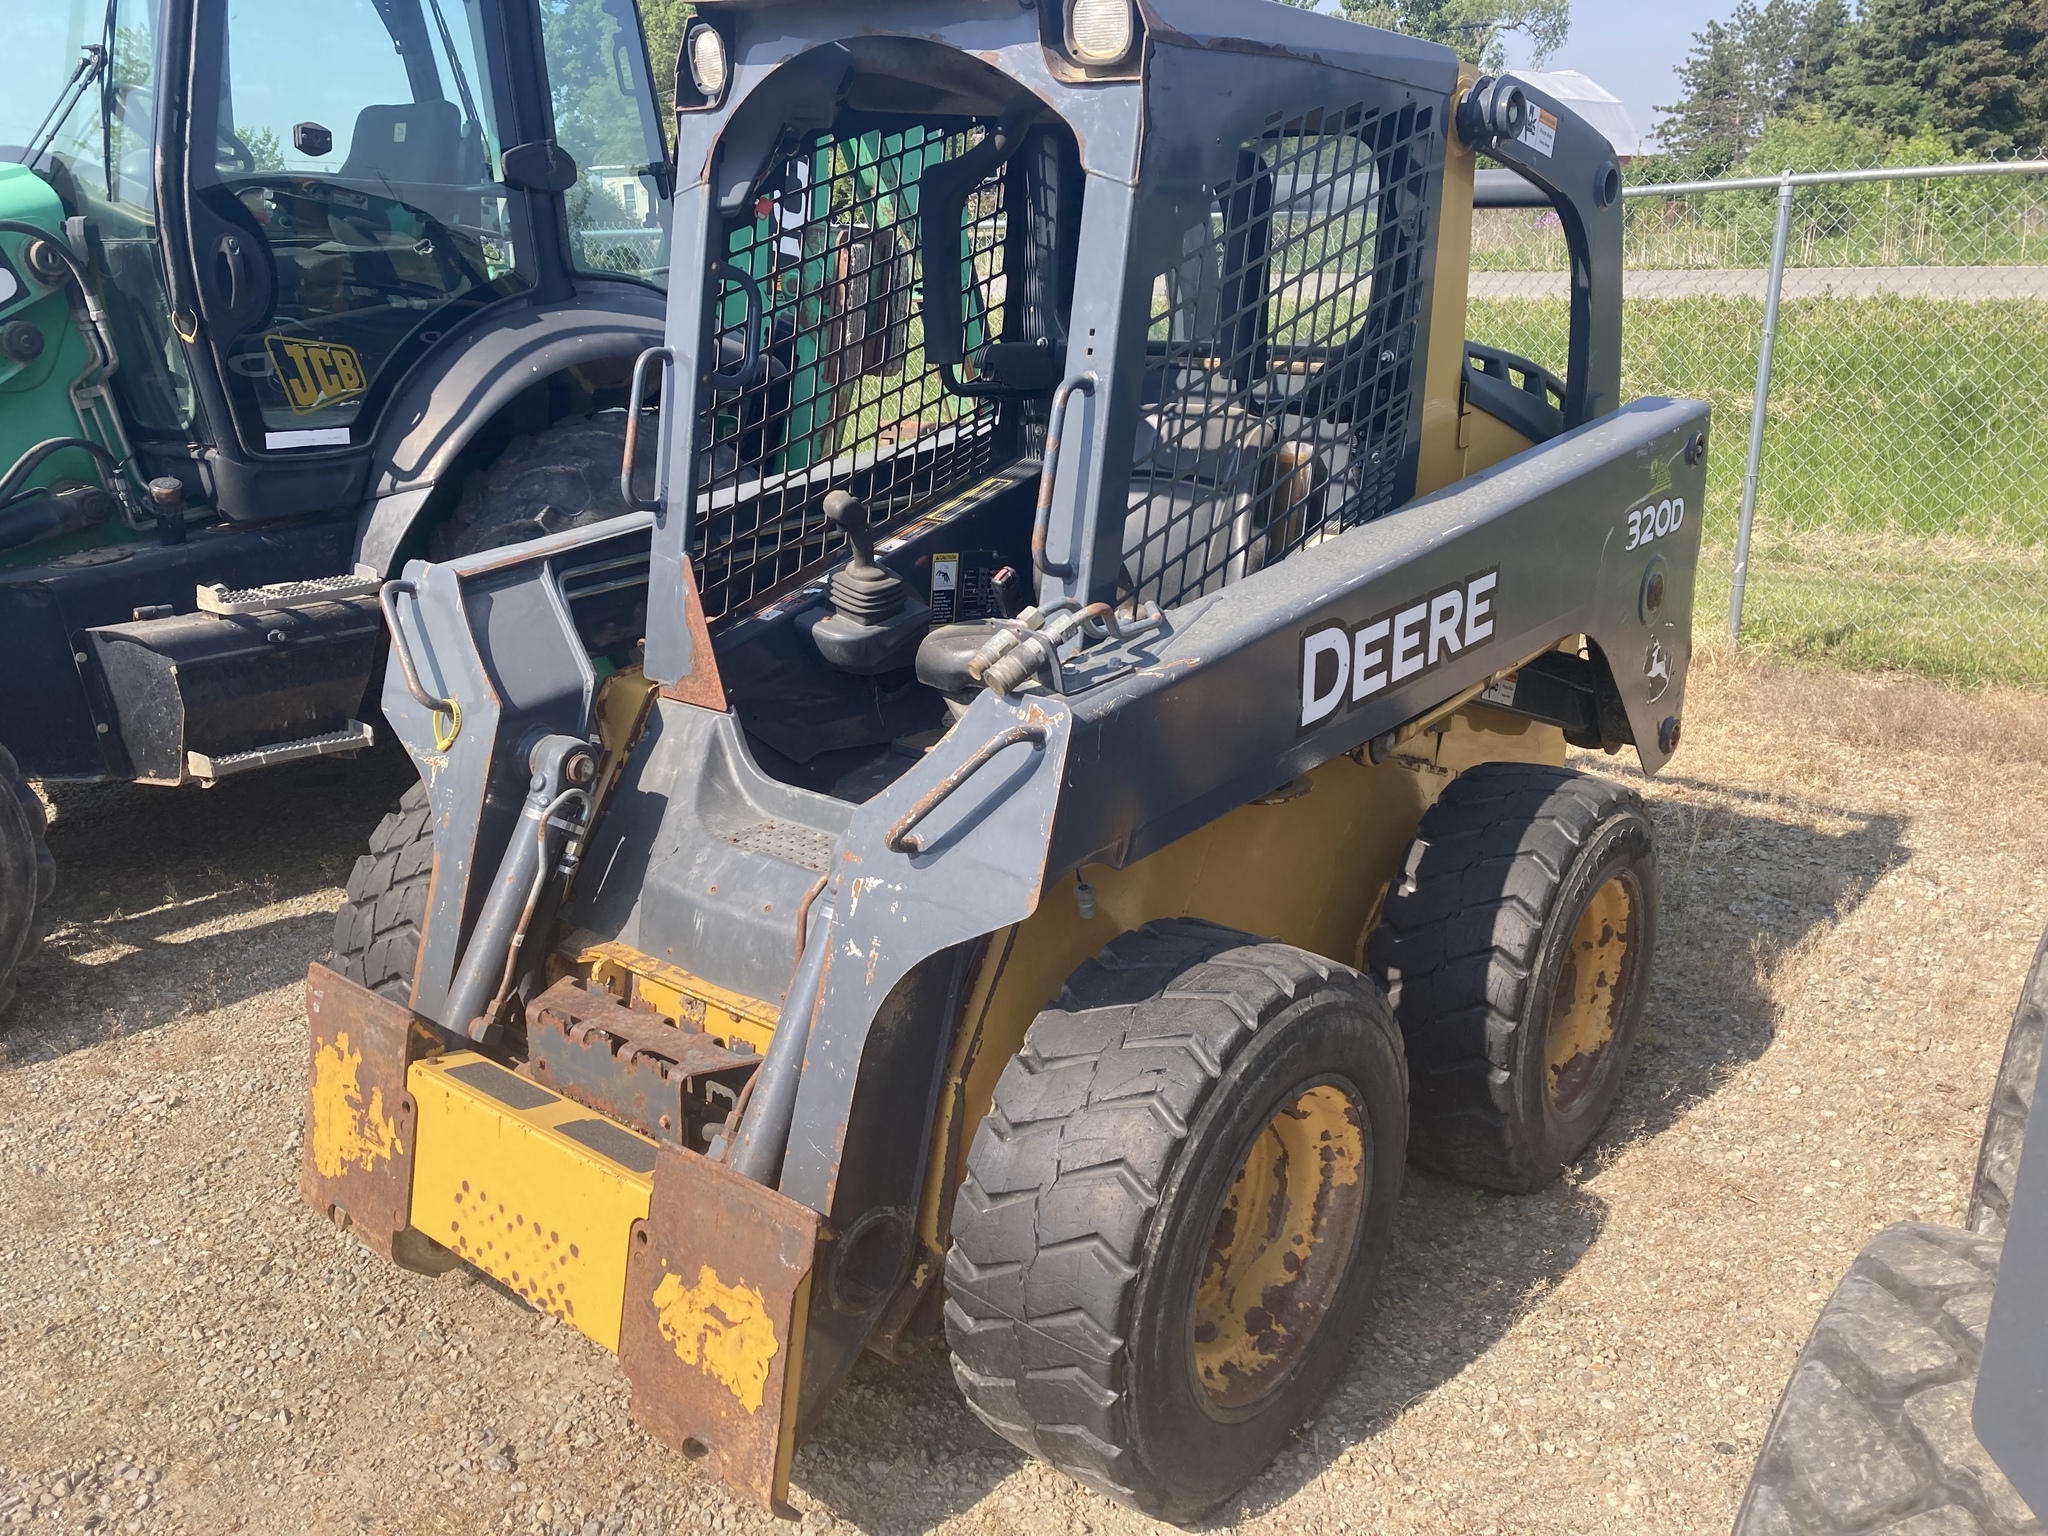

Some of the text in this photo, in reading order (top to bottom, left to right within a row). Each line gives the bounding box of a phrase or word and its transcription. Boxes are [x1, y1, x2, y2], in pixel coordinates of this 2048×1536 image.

[284, 344, 361, 406] JCB
[1625, 497, 1685, 551] 320D
[1302, 571, 1497, 727] DEERE
